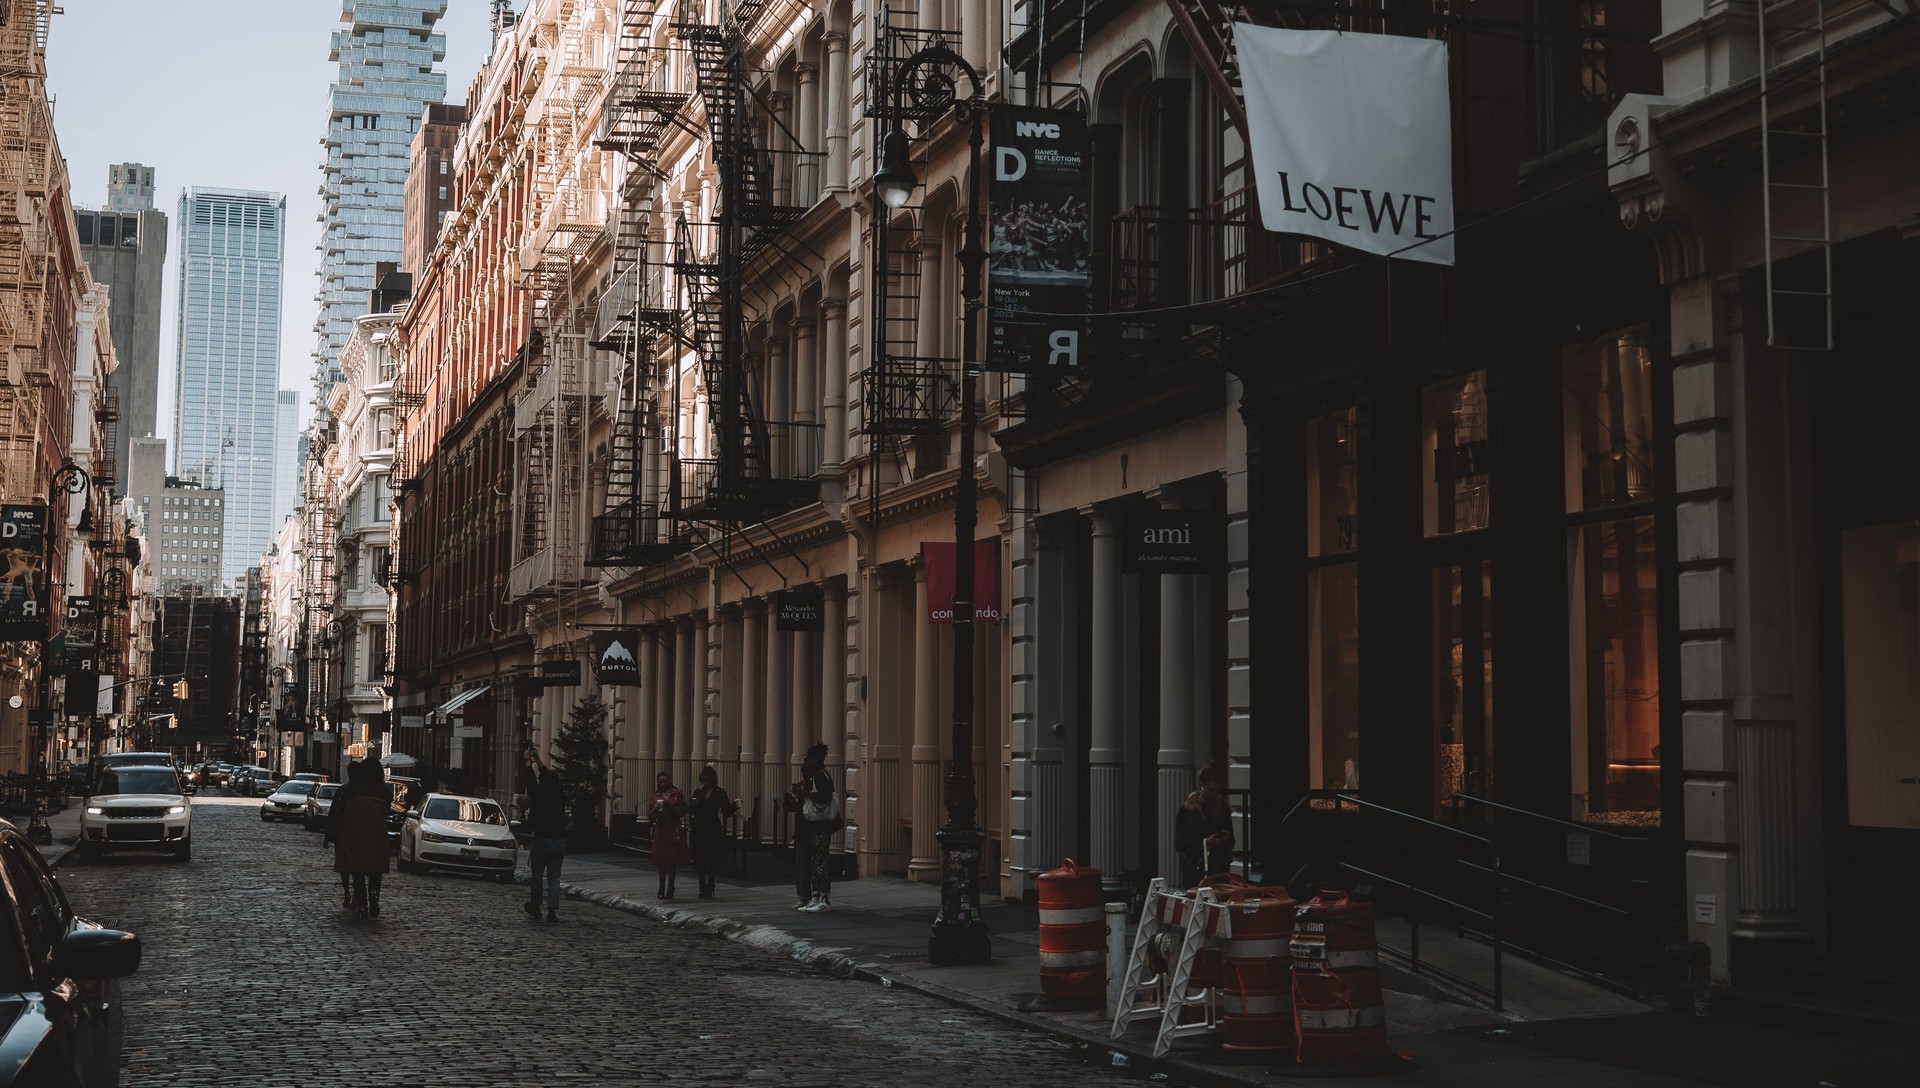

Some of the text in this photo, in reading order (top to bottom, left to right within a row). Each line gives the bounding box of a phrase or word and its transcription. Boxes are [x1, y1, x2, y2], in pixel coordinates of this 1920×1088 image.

[1016, 121, 1061, 139] NYC
[996, 146, 1027, 182] D
[1034, 155, 1081, 163] REFLECTIONS
[1277, 171, 1437, 239] LOEWE
[995, 288, 1031, 297] New York
[13, 511, 34, 519] NYC
[2, 522, 17, 538] D
[1143, 522, 1191, 545] ami
[69, 607, 79, 618] D
[784, 604, 816, 612] Alexander
